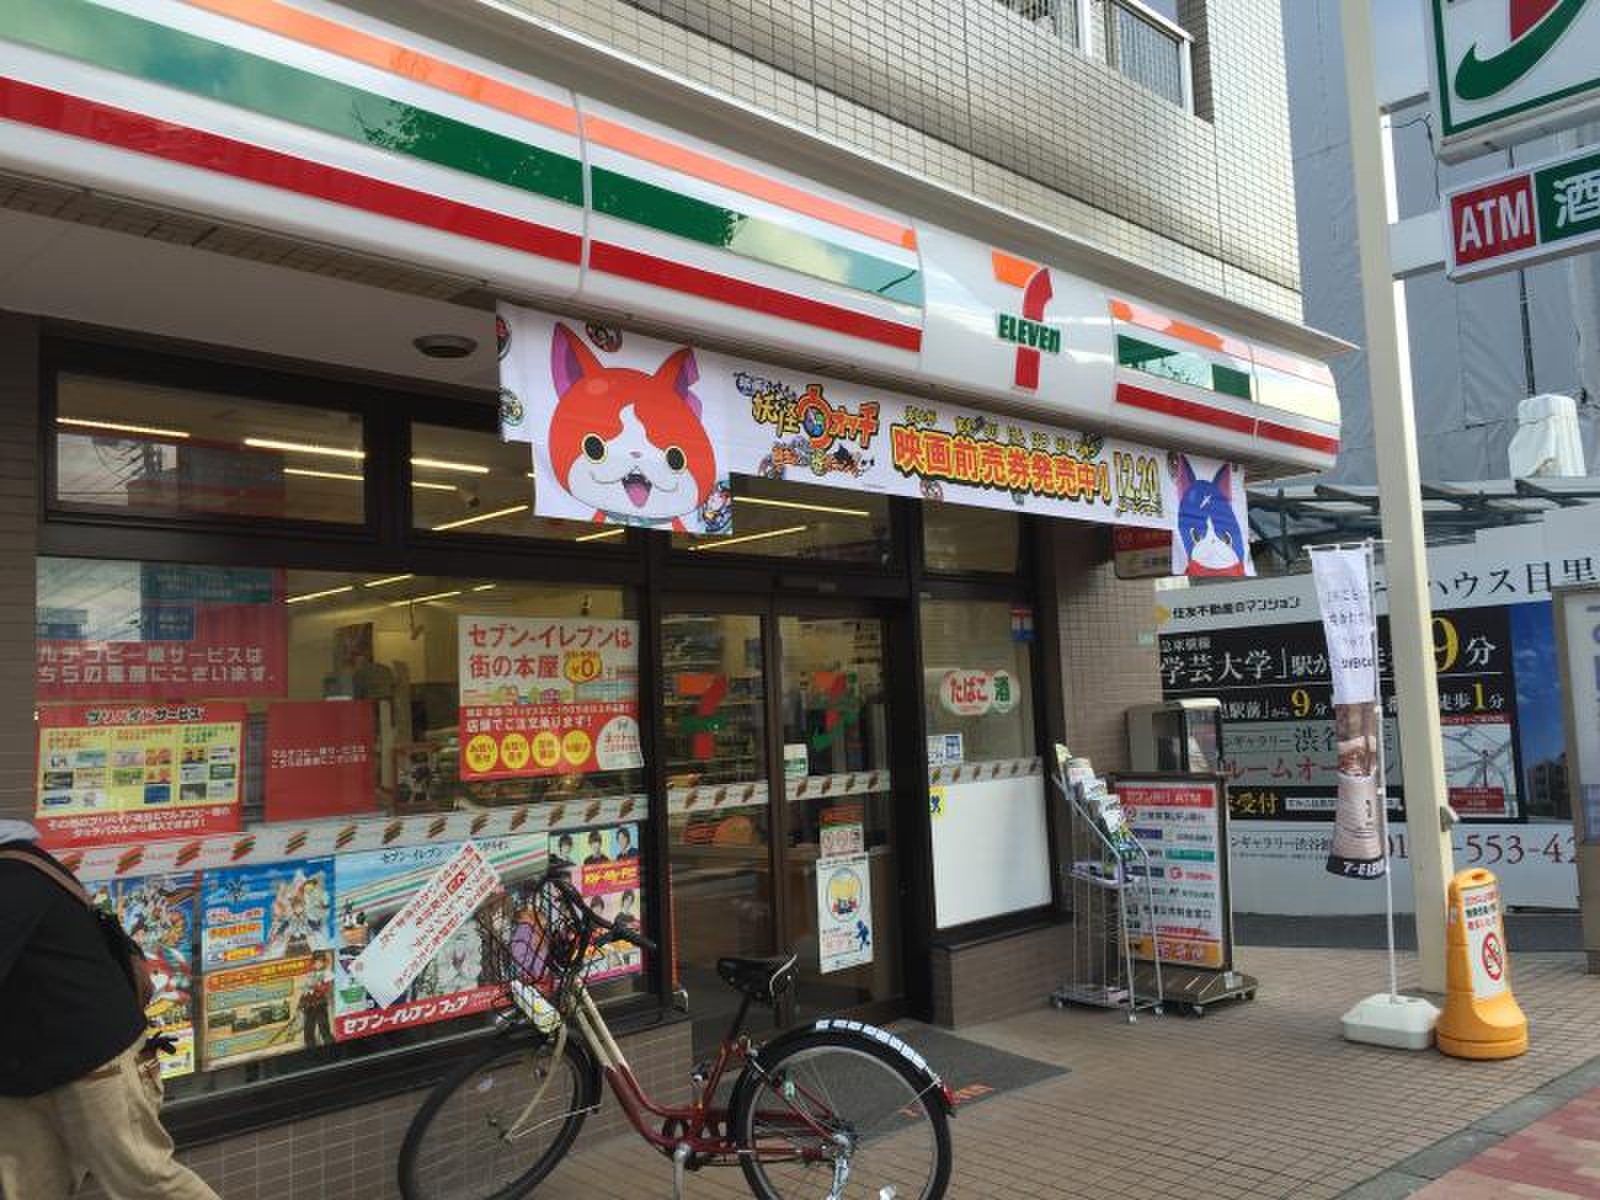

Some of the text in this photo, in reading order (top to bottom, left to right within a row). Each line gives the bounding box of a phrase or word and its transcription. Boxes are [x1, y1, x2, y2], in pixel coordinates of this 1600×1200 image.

[1458, 190, 1532, 253] ATM
[1553, 175, 1600, 228] 酒
[997, 312, 1061, 354] ELEVEN
